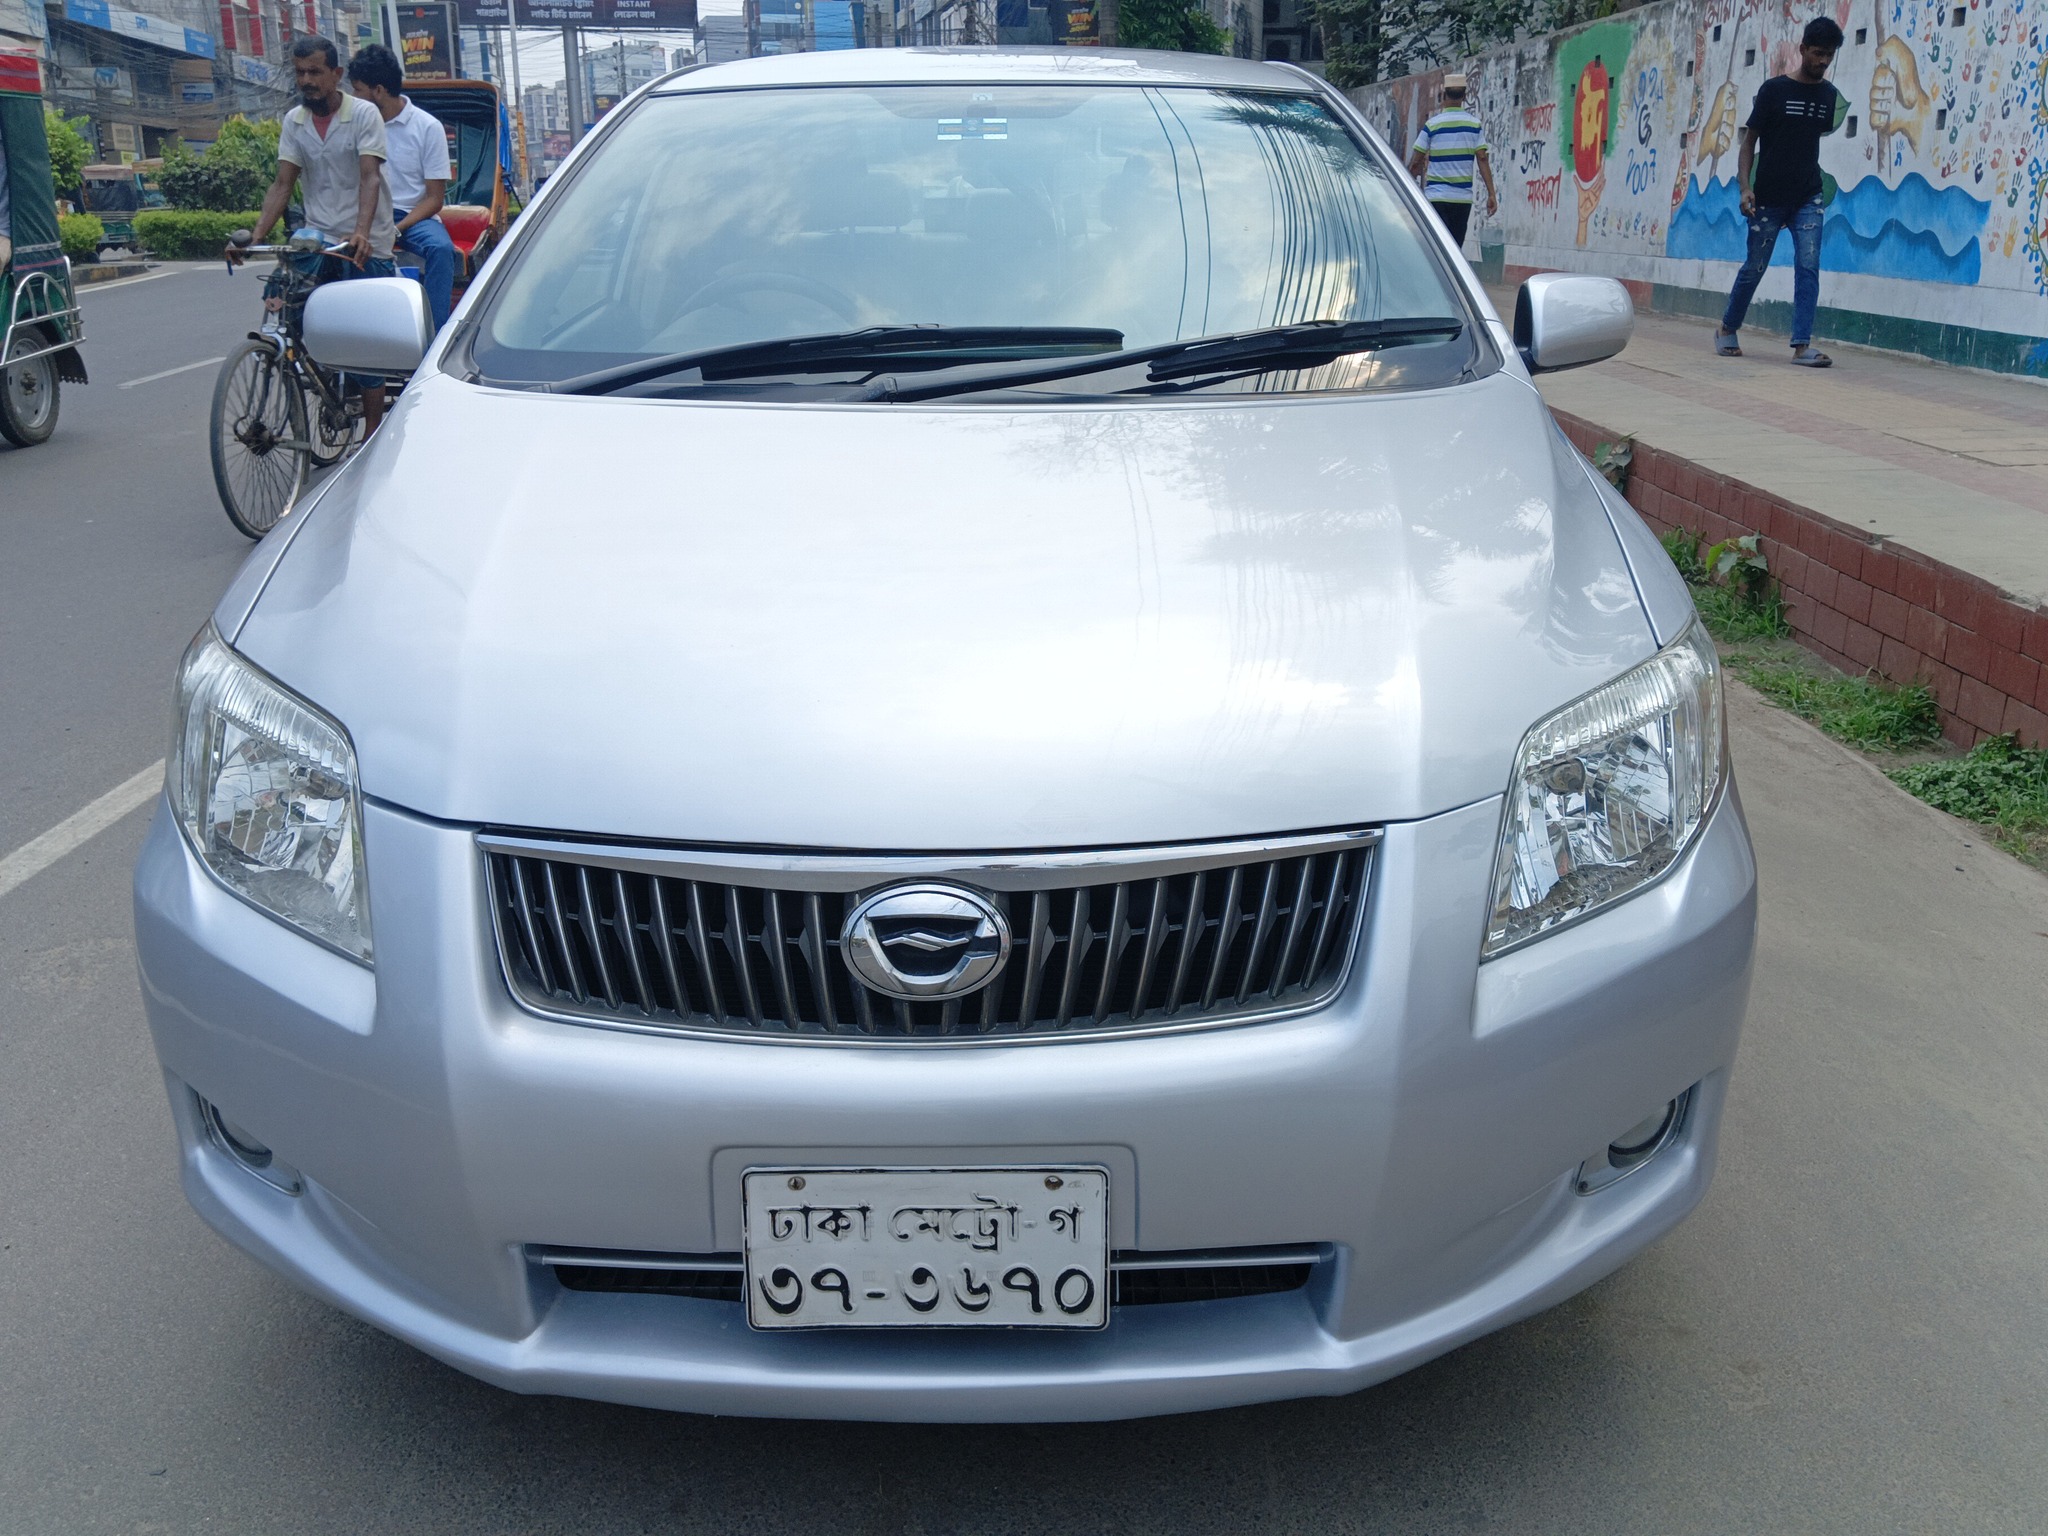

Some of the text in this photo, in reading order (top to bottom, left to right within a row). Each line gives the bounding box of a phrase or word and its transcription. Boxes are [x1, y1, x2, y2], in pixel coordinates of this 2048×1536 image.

[613, 10, 638, 19] লেভেল
[401, 36, 435, 53] WIN
[766, 1200, 874, 1242] ঢাকা
[758, 1263, 1096, 1315] ৩৭-৩৬৭০
